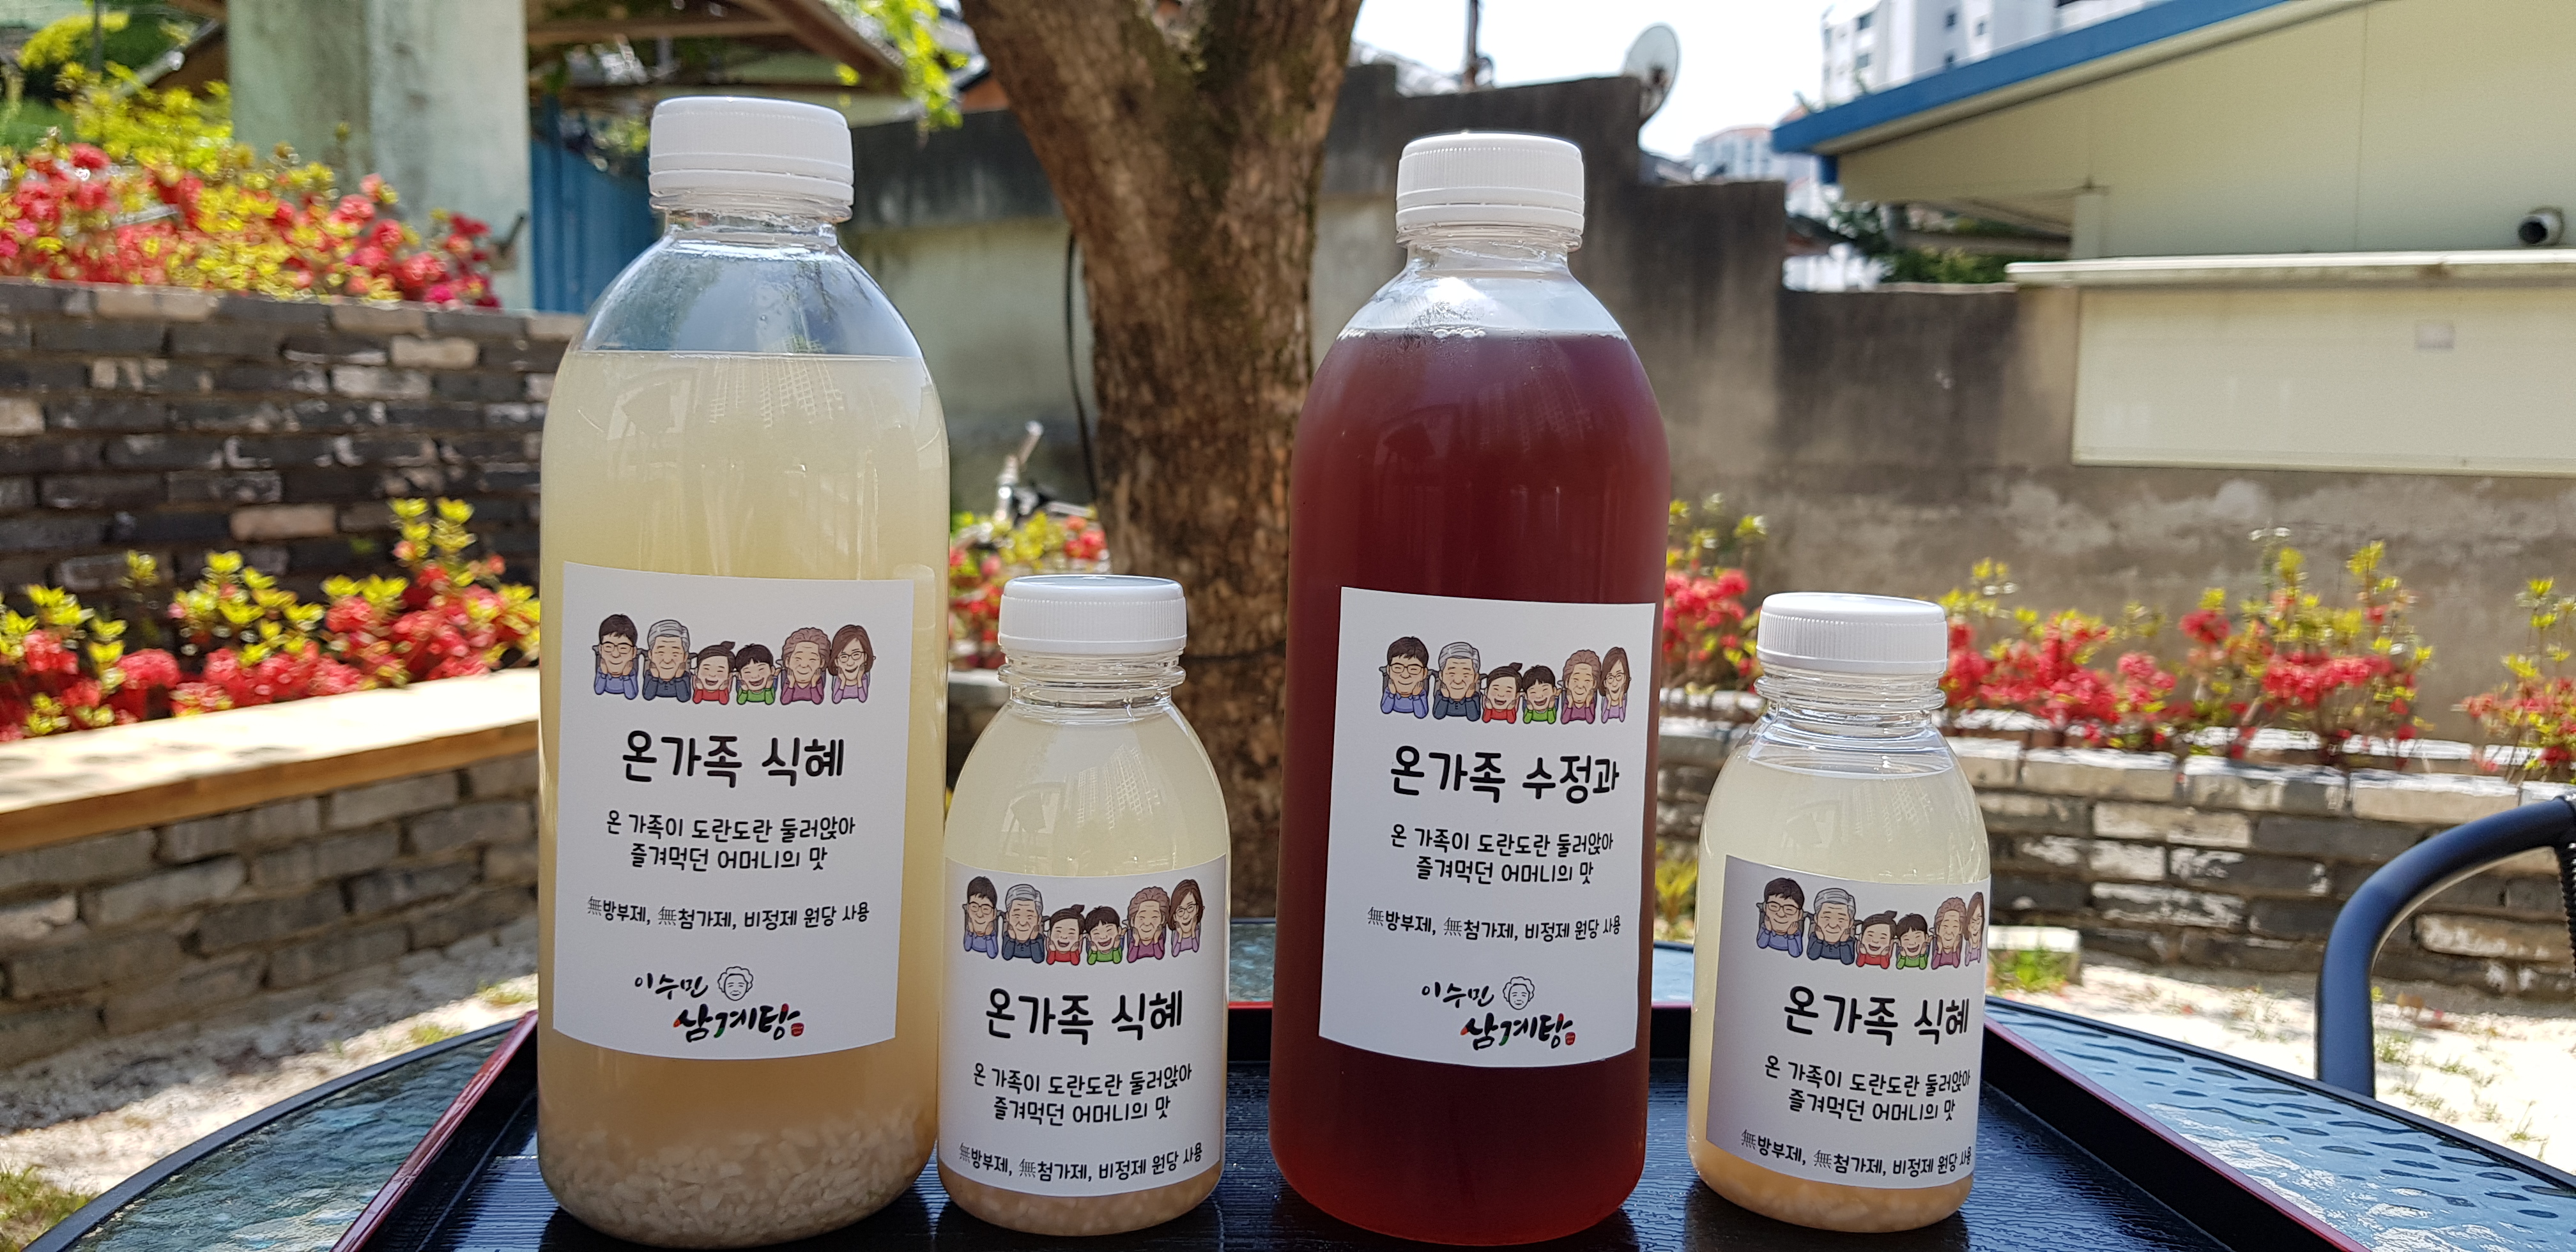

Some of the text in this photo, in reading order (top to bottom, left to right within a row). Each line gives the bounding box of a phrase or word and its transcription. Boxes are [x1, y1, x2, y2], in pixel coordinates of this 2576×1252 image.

[622, 730, 844, 788] 온가족 식혜
[1391, 745, 1620, 804] 온가족 수정과
[607, 810, 855, 843] 온 가족이 도란도란 둘러앉아
[1391, 824, 1613, 857] 온 가족이 도란도란 둘러앉아
[631, 843, 828, 872] 즐겨먹던 어머니의 맛
[1416, 856, 1593, 885] 즐겨먹던 어머니의 맛
[744, 910, 797, 930] 비정제
[804, 906, 837, 928] 원당
[842, 902, 870, 922] 사용
[1525, 922, 1570, 942] 비정제
[1575, 919, 1599, 940] 원당
[1603, 915, 1621, 935] 사용
[634, 973, 709, 1000] 이수민
[1422, 982, 1494, 1008] 이수민
[673, 1004, 801, 1042] 삼계탕
[986, 988, 1182, 1045] 온가족 식혜
[1460, 1012, 1573, 1050] 삼계탕
[1784, 986, 1969, 1046] 온가족 식혜
[974, 1063, 1192, 1098] 온 가족이 도란도란 둘러앉아
[1765, 1055, 1970, 1097] 온 가족이 도란도란 둘러앉아
[994, 1096, 1170, 1126] 즐겨먹던 어머니의 맛
[1789, 1088, 1955, 1122] 즐겨먹던 어머니의 맛
[1099, 1159, 1146, 1180] 비정제
[1152, 1152, 1179, 1175] 원당
[1183, 1142, 1202, 1164] 사용
[1893, 1159, 1934, 1177] 비정제
[1938, 1154, 1958, 1174] 원당
[1959, 1147, 1972, 1166] 사용
